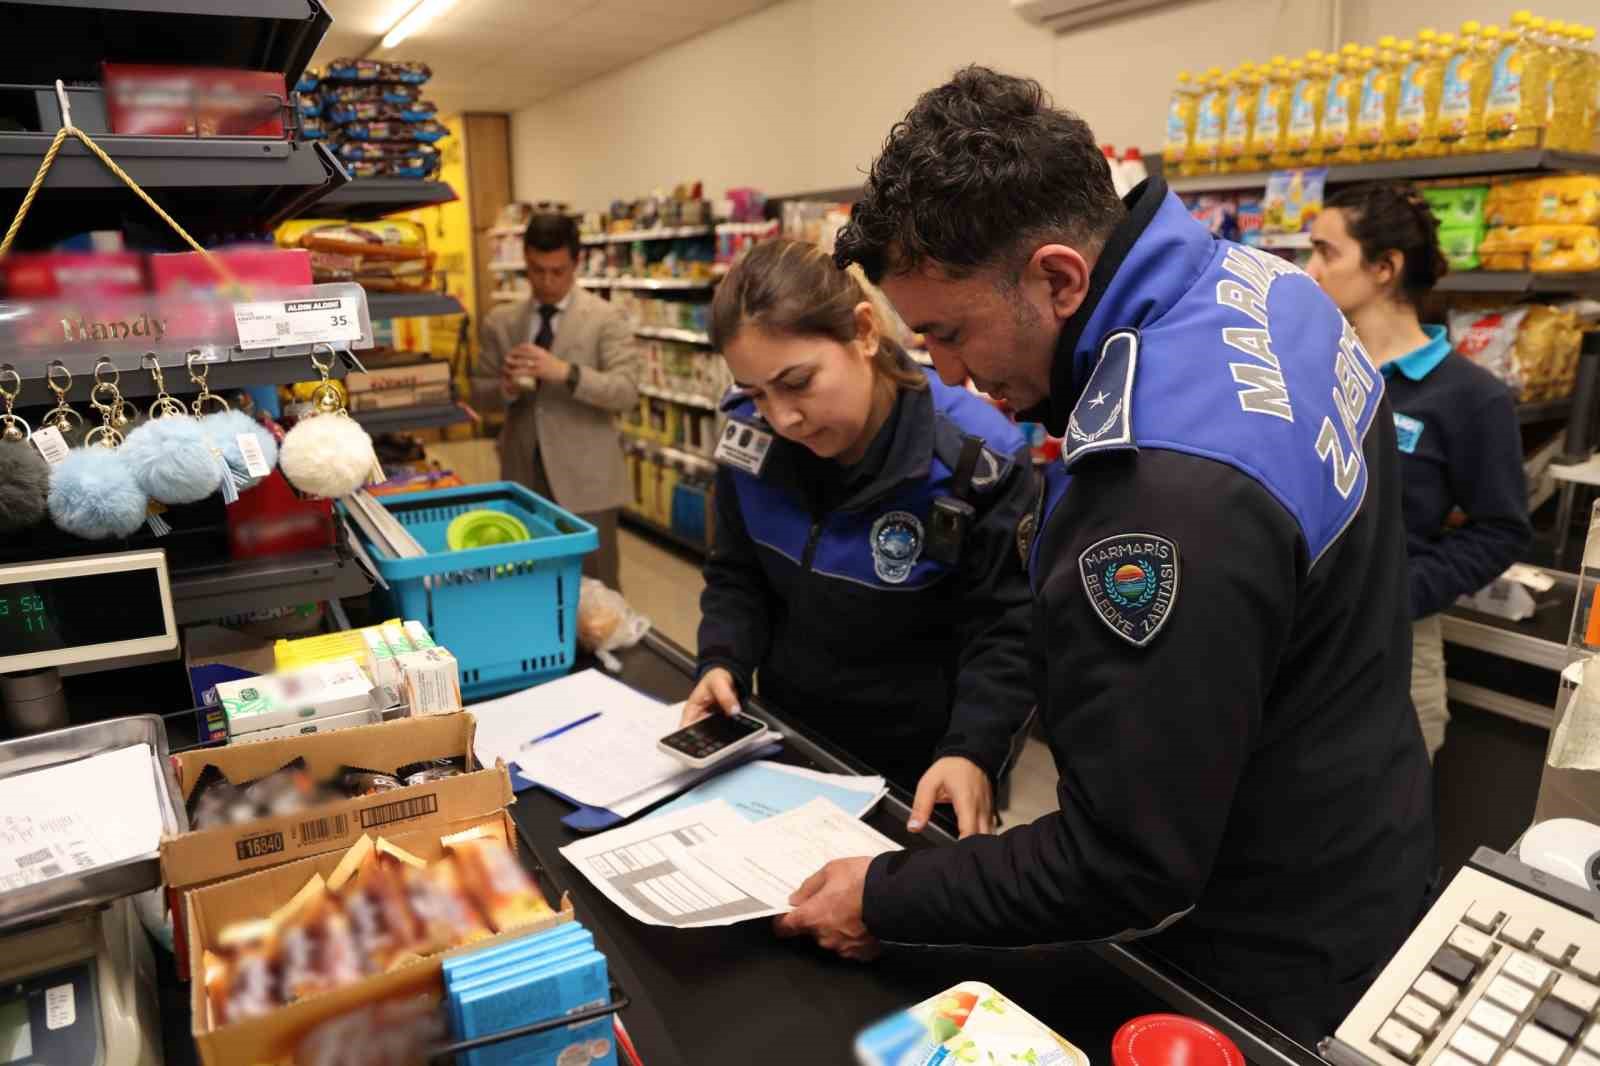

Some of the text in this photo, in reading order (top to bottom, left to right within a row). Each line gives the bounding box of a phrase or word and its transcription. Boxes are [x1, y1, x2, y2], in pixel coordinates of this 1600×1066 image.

[329, 314, 348, 327] 35
[1085, 541, 1170, 569] MARMARİS
[1140, 563, 1174, 633] ZABITASI
